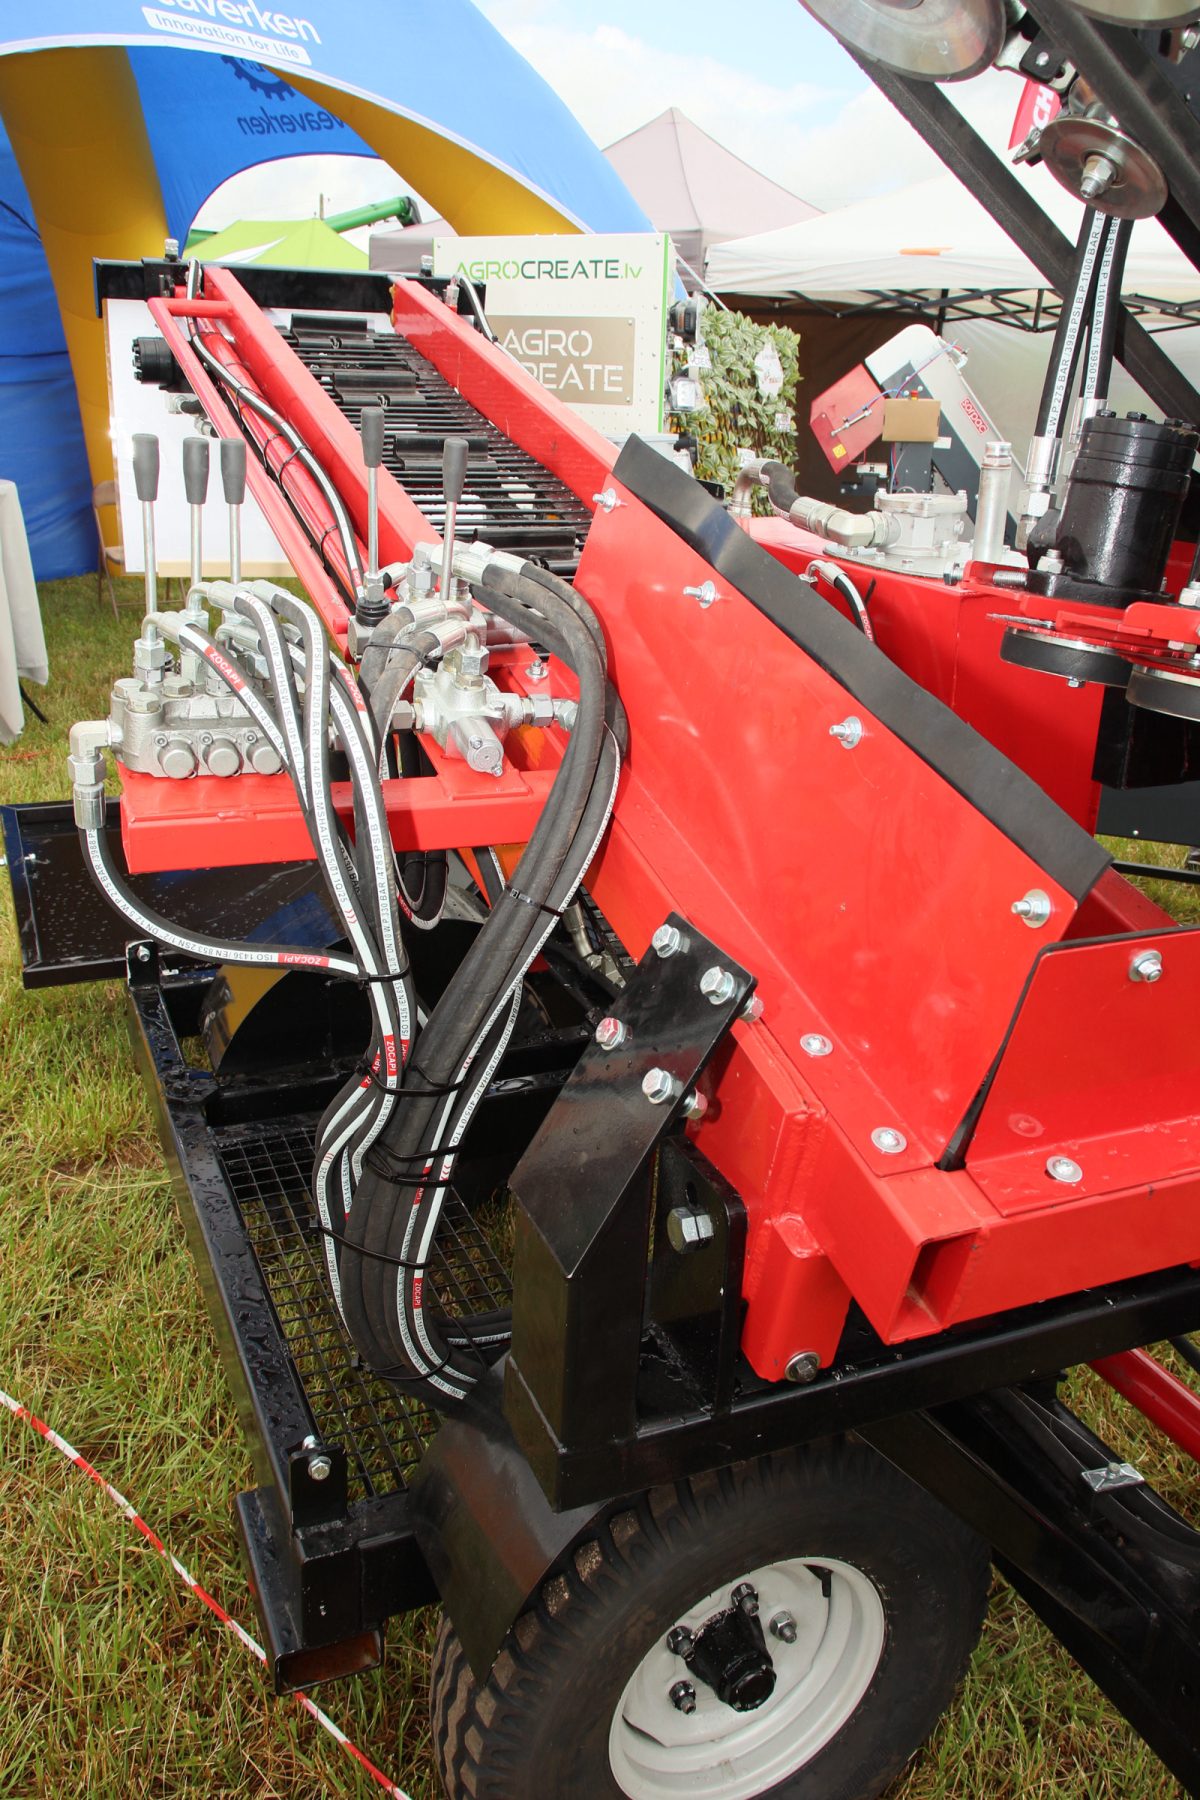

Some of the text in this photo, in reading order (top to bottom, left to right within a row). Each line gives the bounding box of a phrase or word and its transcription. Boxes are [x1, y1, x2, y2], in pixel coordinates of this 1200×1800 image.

[155, 13, 301, 60] Innovation for Life
[1103, 237, 1115, 257] PSI
[1057, 357, 1069, 382] BAR
[1070, 306, 1082, 324] PSI
[1086, 230, 1100, 255] BAR
[1093, 310, 1103, 334] BAR
[502, 328, 593, 357] AGRO
[1088, 343, 1099, 374] 15950
[1085, 375, 1095, 394] PSI
[266, 626, 280, 657] 405/01
[273, 657, 282, 670] IC
[313, 647, 321, 662] PSI
[208, 649, 241, 685] ZOCAPI
[242, 690, 259, 710] ISO
[255, 709, 275, 733] 1436
[275, 671, 290, 704] MSHA
[283, 705, 294, 725] PSI
[333, 701, 347, 718] PSI
[311, 711, 320, 735] BAR
[341, 717, 359, 746] 19140
[287, 726, 302, 757] 19140
[312, 746, 321, 778] 19140
[354, 755, 368, 780] BAR
[313, 781, 323, 799] PSI
[315, 801, 327, 832] MSHA
[320, 834, 330, 845] IC
[372, 833, 381, 851] PSI
[323, 846, 339, 876] 405/01
[94, 862, 108, 883] BAR
[333, 877, 348, 903] 1Q/25
[378, 882, 387, 901] BAR
[127, 909, 146, 926] 12.5
[144, 922, 159, 934] DN
[383, 933, 392, 941] 10
[177, 938, 196, 950] 2SN
[197, 944, 214, 954] 853
[385, 943, 394, 953] DN
[232, 951, 252, 960] 1436
[283, 953, 321, 965] ZOCAPI
[400, 1006, 408, 1022] 1436
[498, 1027, 511, 1049] 15950
[385, 1039, 396, 1071] ZOCAPI
[490, 1048, 502, 1064] PSI
[478, 1064, 495, 1089] MSHA
[472, 1088, 482, 1099] IC
[457, 1099, 477, 1129] 405/01
